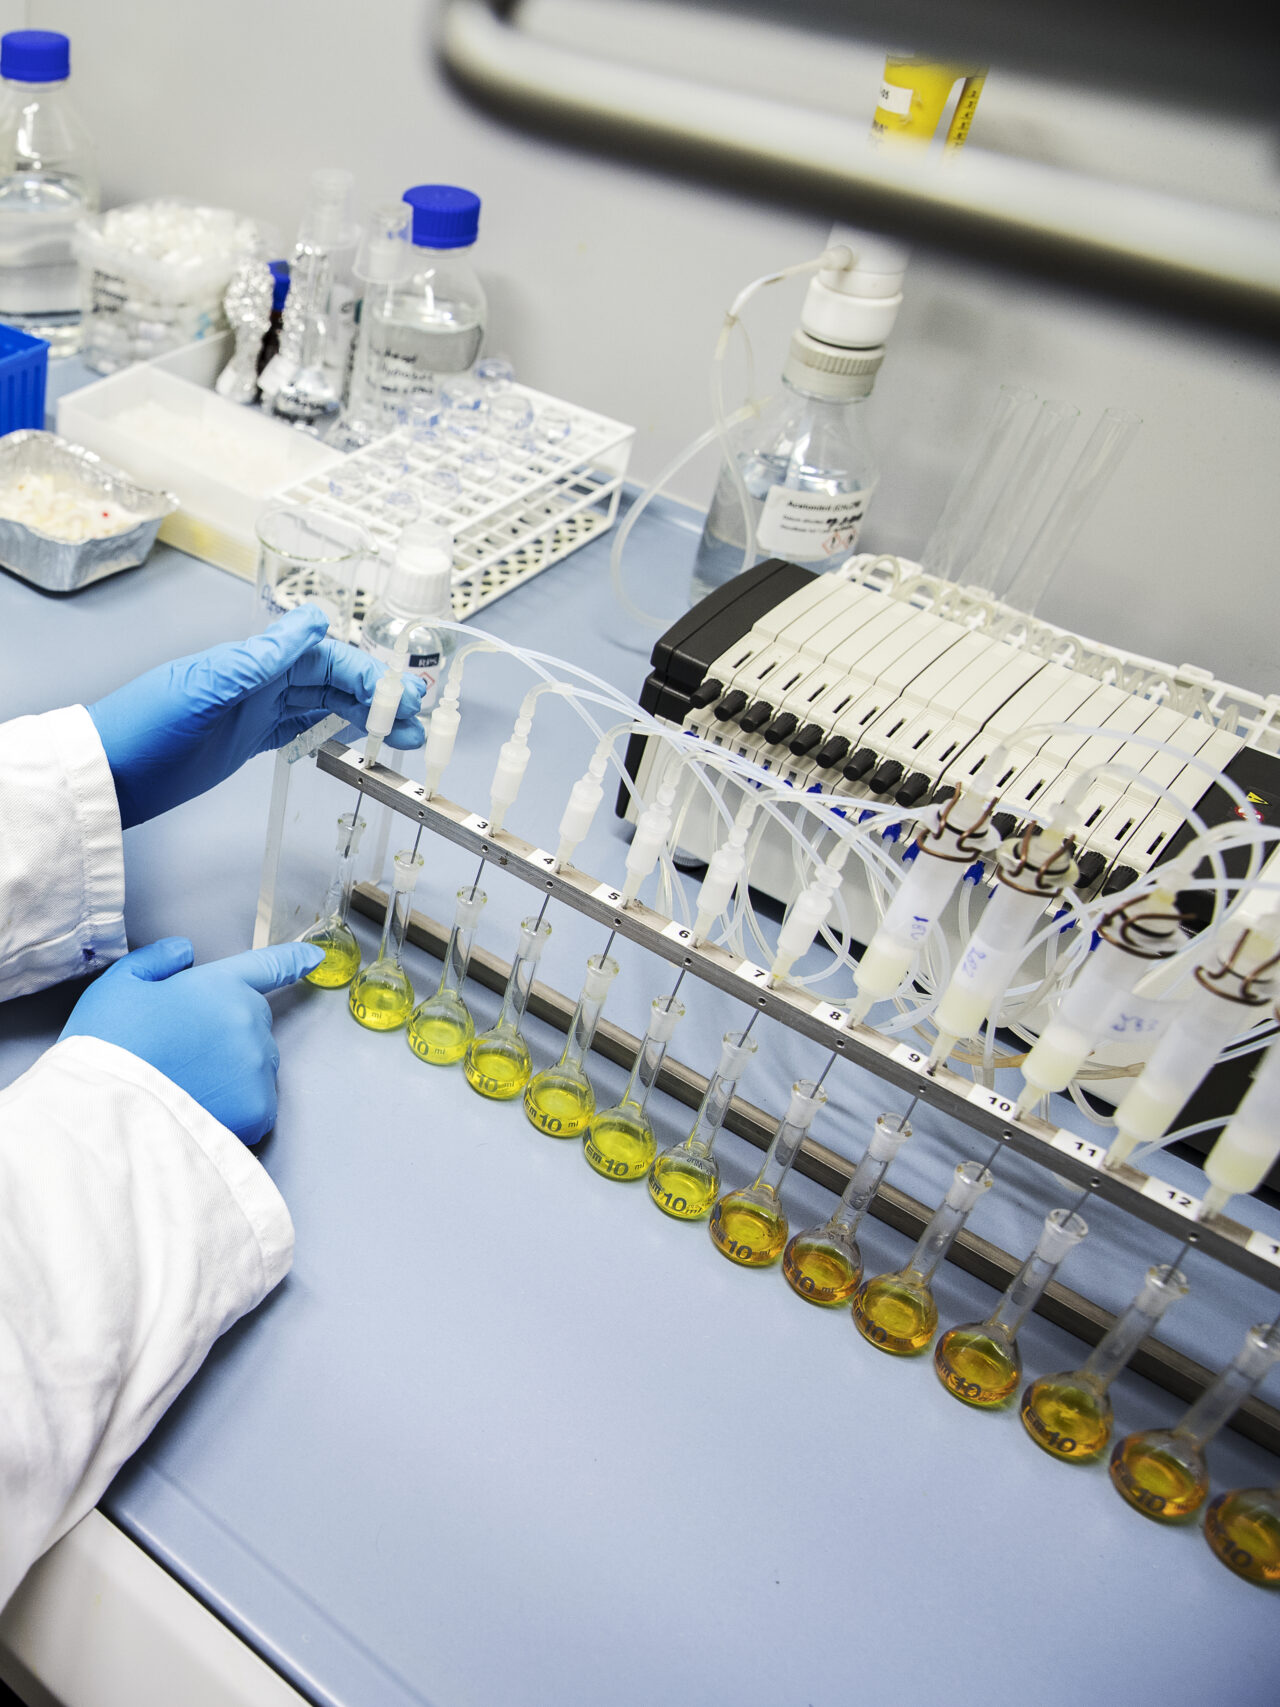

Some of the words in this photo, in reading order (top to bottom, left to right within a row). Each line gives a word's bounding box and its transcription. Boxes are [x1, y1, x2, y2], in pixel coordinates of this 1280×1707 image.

[414, 788, 424, 796] 2
[477, 821, 489, 829] 3
[608, 892, 620, 900] 5
[679, 930, 690, 939] 6
[753, 969, 765, 978] 7
[351, 998, 367, 1019] 10
[829, 1011, 842, 1021] 8
[410, 1035, 429, 1056] 10
[434, 1047, 445, 1055] ml
[908, 1053, 920, 1062] 9
[474, 1074, 498, 1092] 10
[988, 1096, 1011, 1112] 10
[539, 1113, 562, 1132] 10
[568, 1120, 578, 1128] ml
[1075, 1141, 1097, 1157] 11
[604, 1159, 629, 1176] 10
[634, 1162, 645, 1170] ml
[663, 1193, 687, 1212] 10
[686, 1207, 702, 1215] ml
[1167, 1191, 1192, 1208] 12
[727, 1240, 752, 1260] 10
[793, 1269, 815, 1293] 10
[865, 1320, 887, 1343] 10
[953, 1375, 982, 1398] 10
[1048, 1431, 1077, 1452] 10
[1137, 1488, 1166, 1512] 10
[1223, 1538, 1254, 1568] 10
